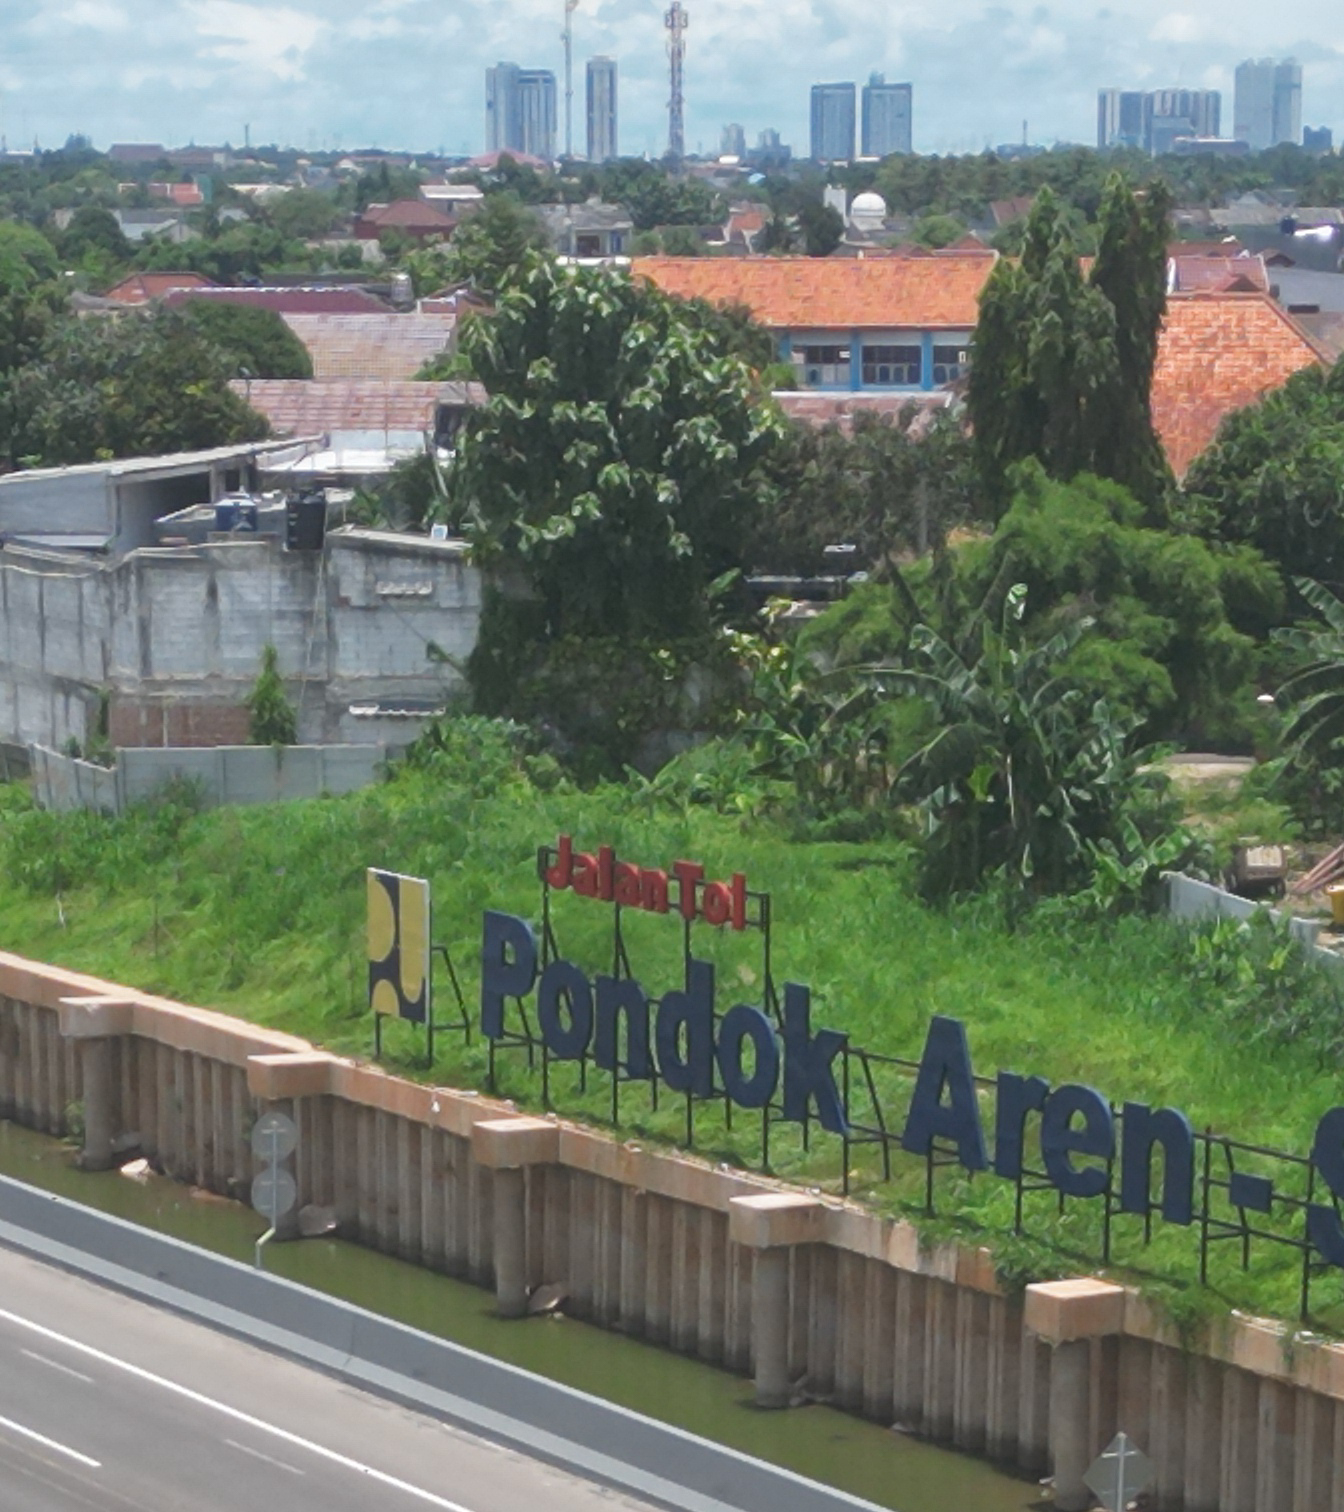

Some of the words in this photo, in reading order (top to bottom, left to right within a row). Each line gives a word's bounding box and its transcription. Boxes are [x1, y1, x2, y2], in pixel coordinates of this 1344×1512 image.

[546, 835, 669, 914] Jalan
[674, 859, 746, 931] Tol
[481, 909, 848, 1134] Pondok
[901, 1015, 1194, 1225] Aren
